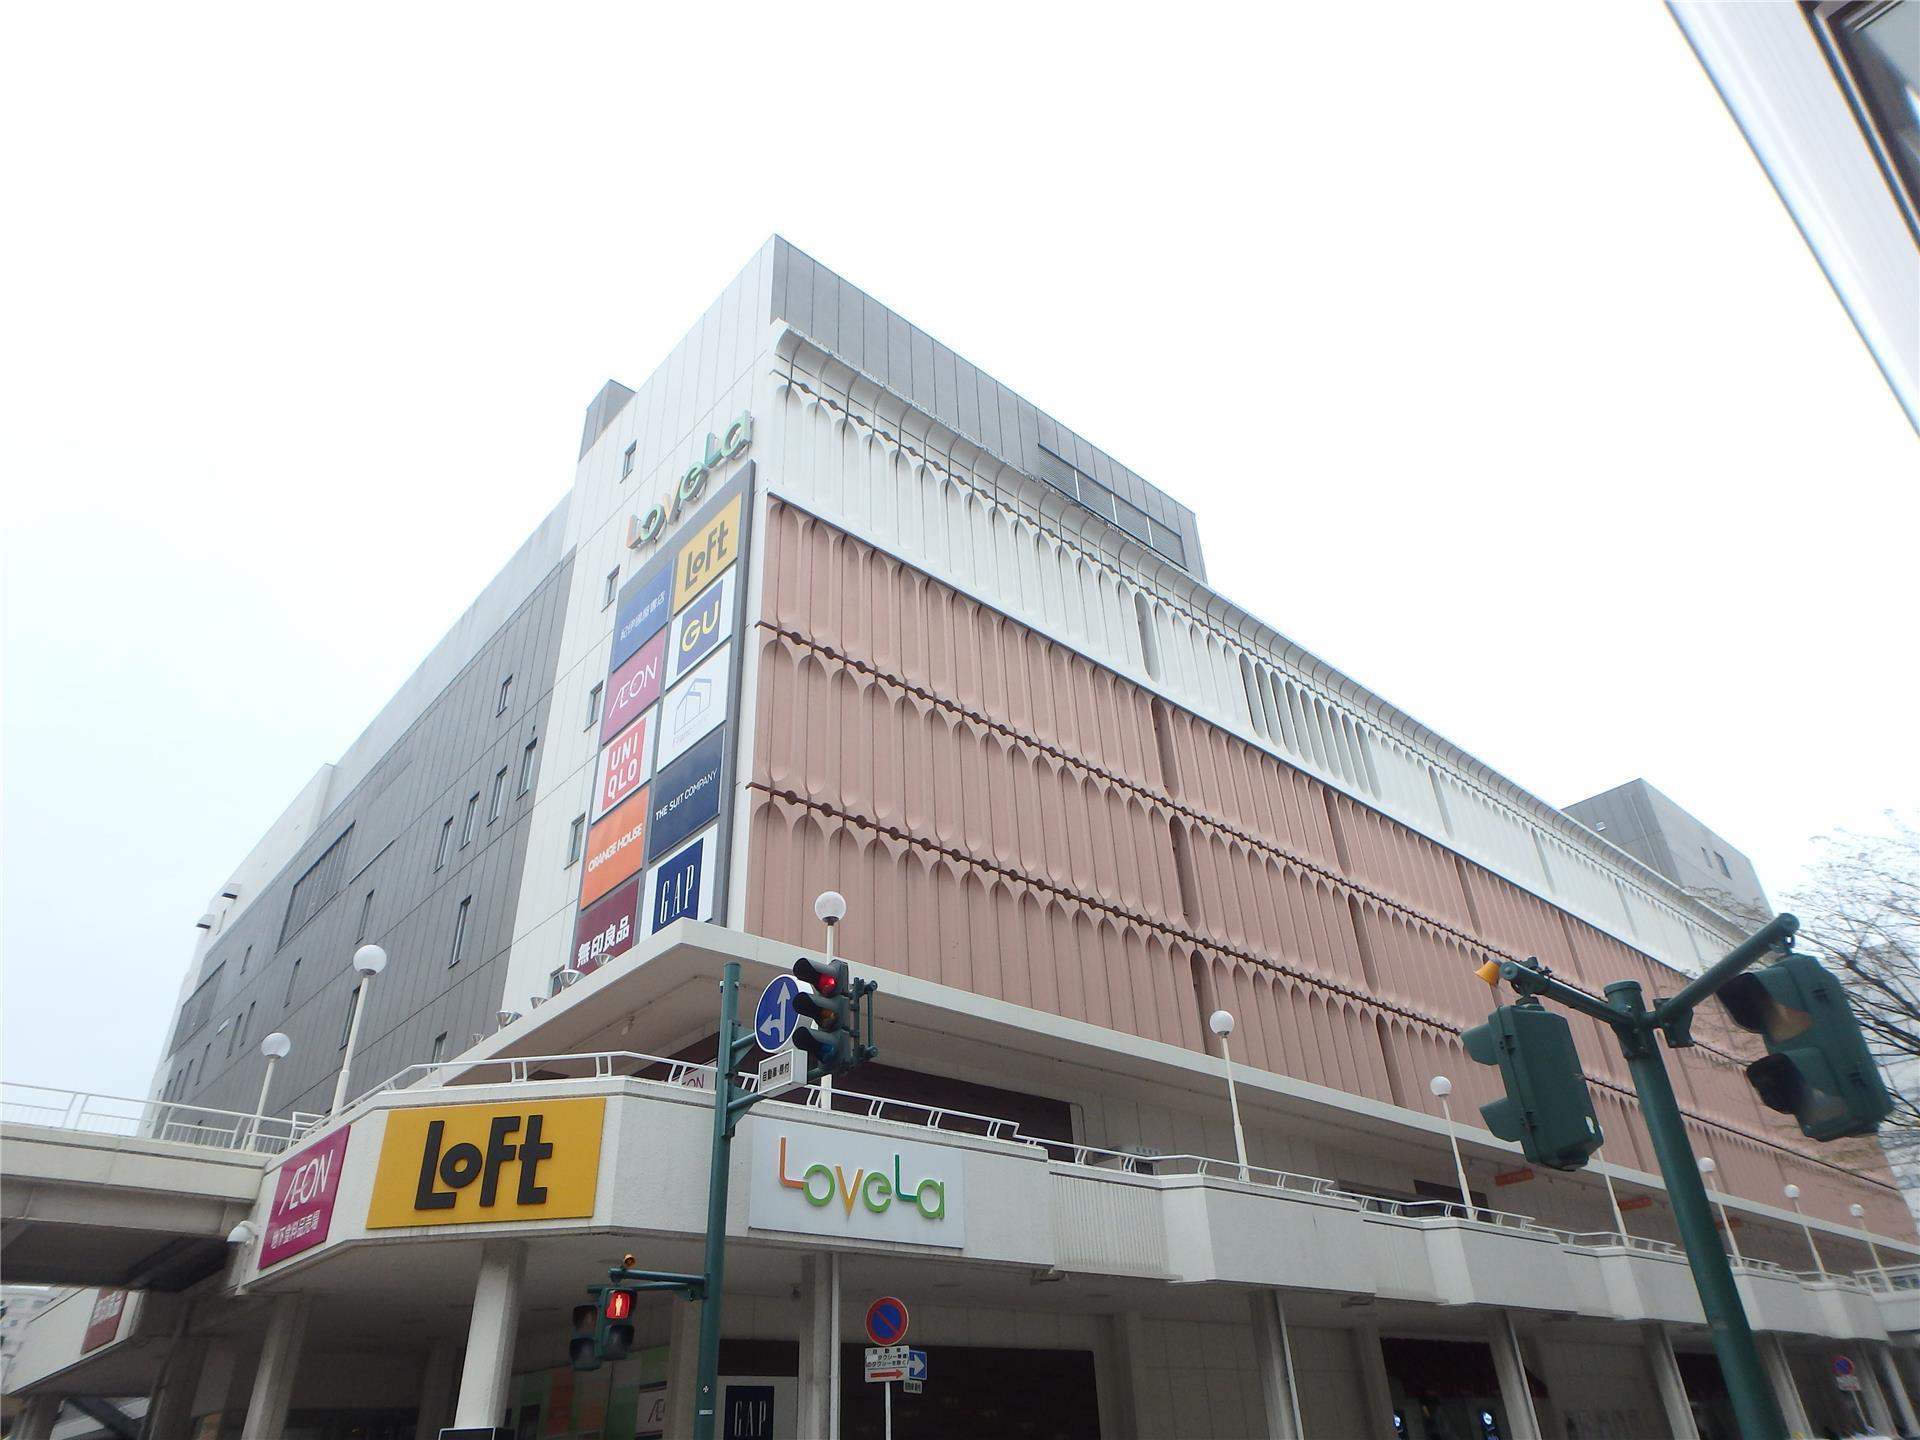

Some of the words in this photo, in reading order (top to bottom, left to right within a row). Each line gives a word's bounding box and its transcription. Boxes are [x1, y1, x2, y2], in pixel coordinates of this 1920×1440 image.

[681, 600, 719, 653] GU
[611, 732, 639, 770] UNI
[607, 758, 638, 799] QLO
[655, 804, 669, 821] THE
[669, 793, 684, 811] SUIT
[684, 767, 718, 800] COMPANY
[616, 823, 643, 851] HOUSE
[660, 864, 695, 924] GAP
[576, 915, 630, 968] 無印良品
[734, 1400, 767, 1437] GAP
